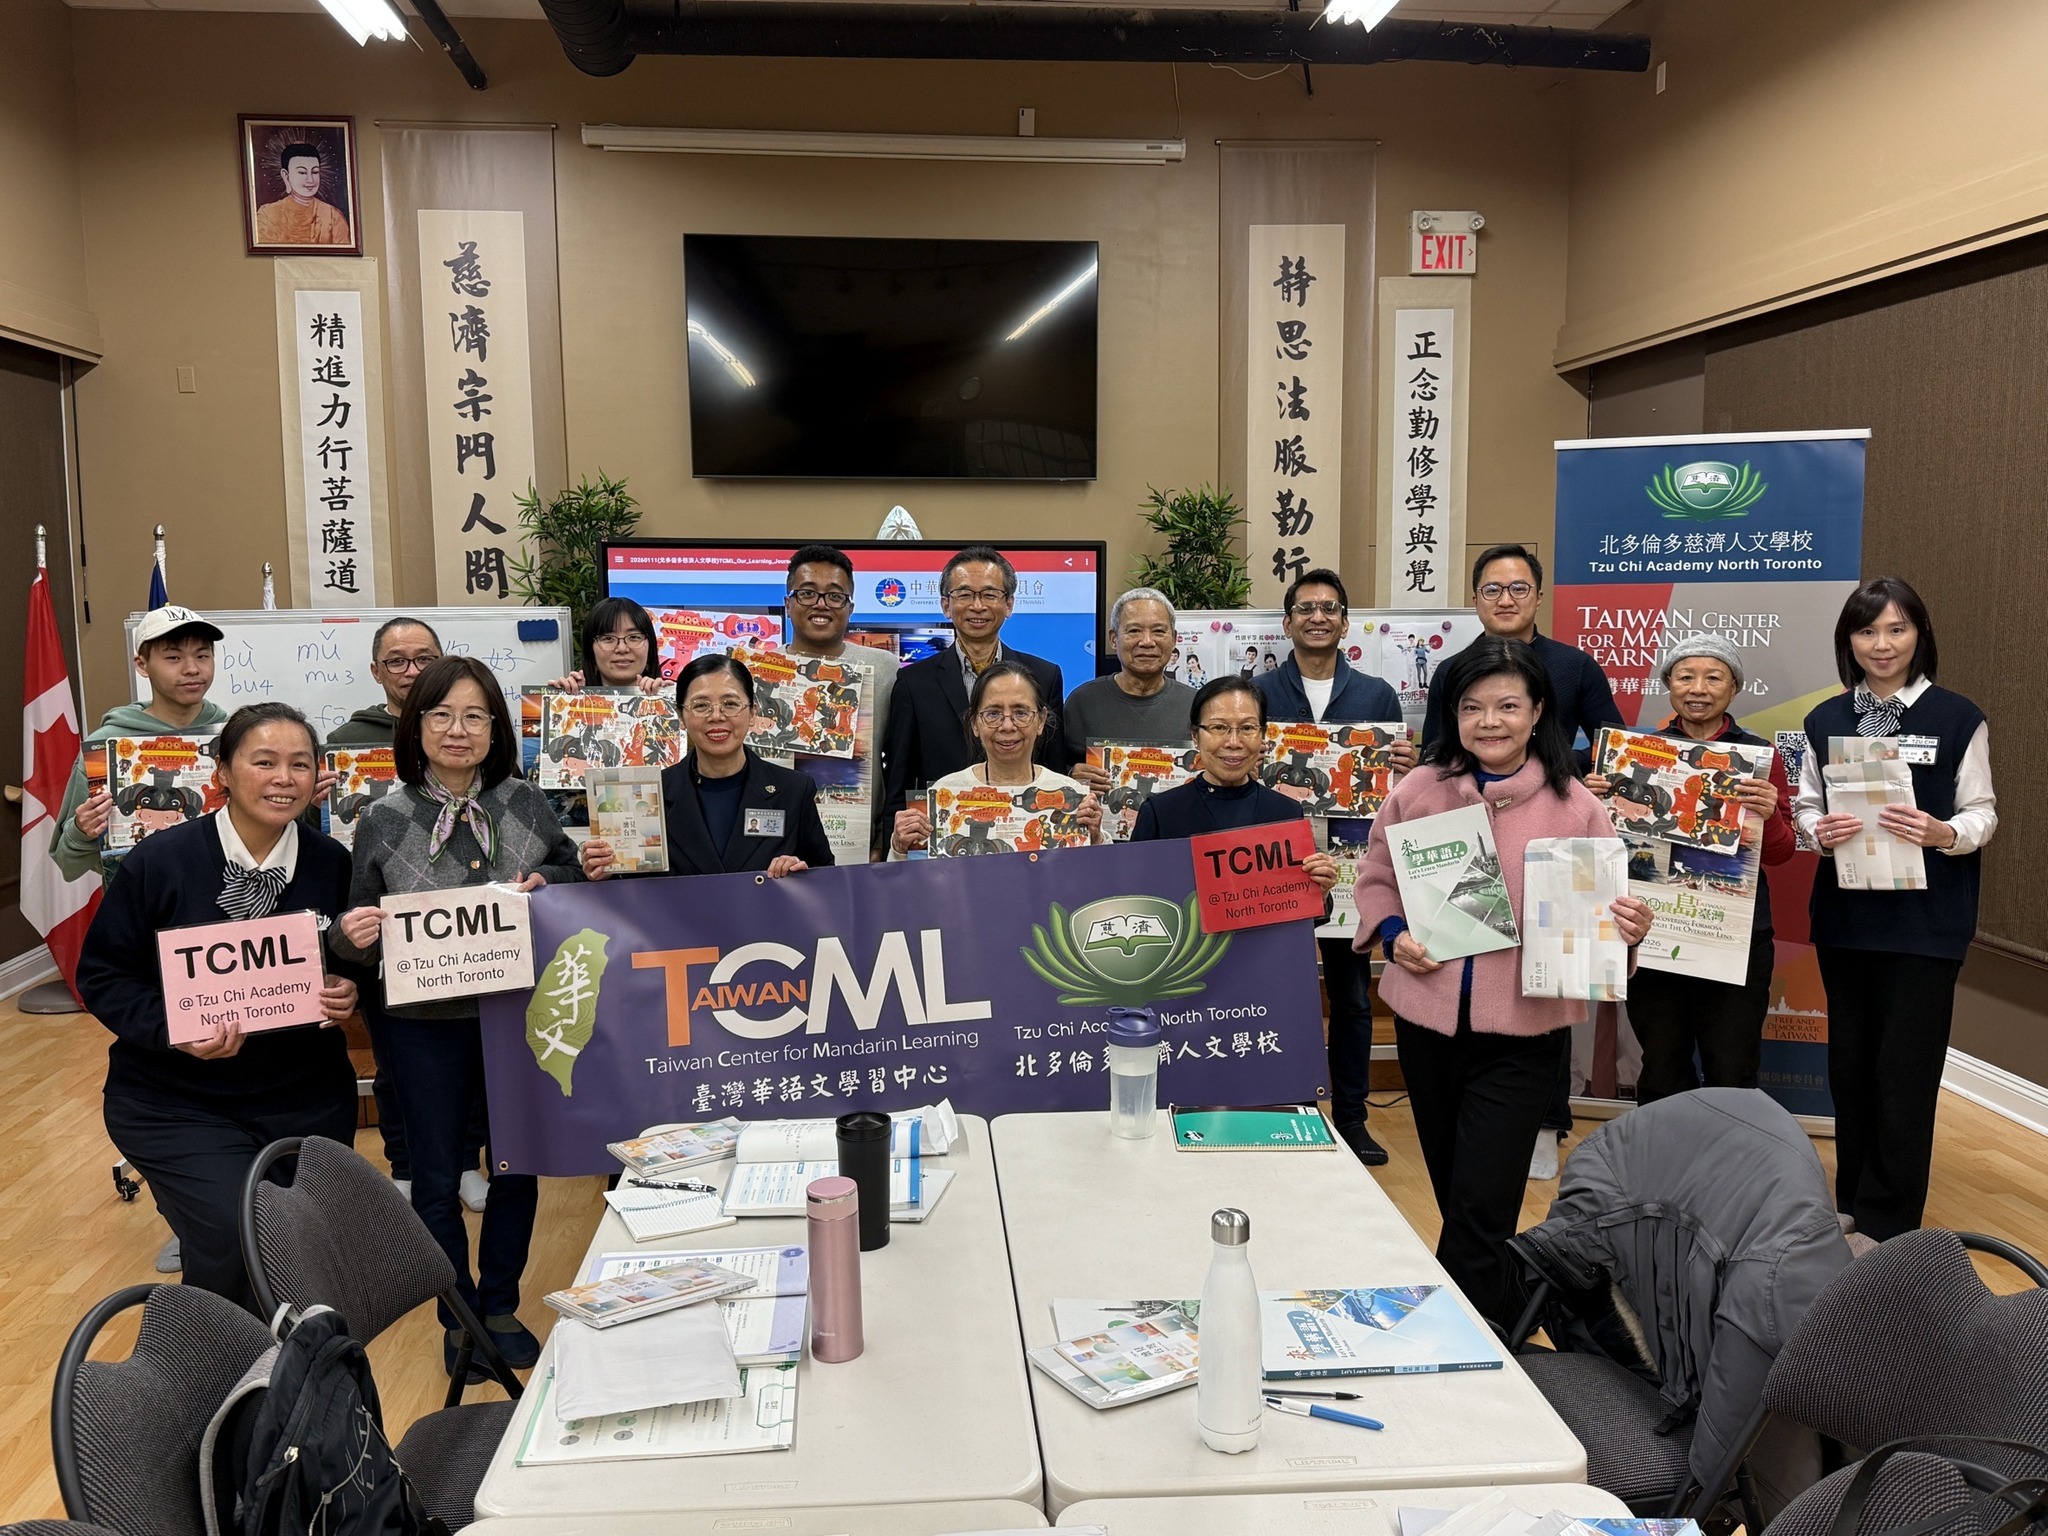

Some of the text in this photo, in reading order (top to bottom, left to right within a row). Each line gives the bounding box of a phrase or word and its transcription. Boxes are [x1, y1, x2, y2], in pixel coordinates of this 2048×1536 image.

[1421, 235, 1467, 269] EXIT
[443, 242, 507, 599] 慈濟宗門人間
[310, 313, 360, 594] 精進力行菩薩道
[1404, 331, 1442, 593] 正念勤修學與覺
[1599, 530, 1813, 556] 北多倫多慈濟人文學校
[1589, 557, 1822, 574] Tzu Chi Academy North Toronto
[1577, 606, 1781, 629] TAIWAN CENTER
[1577, 634, 1616, 648] FOR
[230, 674, 274, 695] bu4
[1204, 839, 1304, 878] TCML
[1436, 860, 1460, 868] Mandarin
[1209, 880, 1311, 905] @ Tzu Chi Academy
[1225, 899, 1298, 919] North Toronto
[394, 902, 517, 943] TCML
[174, 934, 307, 979] TCML
[397, 949, 520, 973] @ Tzu Chi Academy
[416, 968, 505, 988] North Toronto
[631, 928, 992, 1047] TCML
[179, 981, 312, 1011] @ Tzu Chi Academy
[535, 943, 593, 1062] 華文
[200, 1001, 295, 1027] North Toronto
[1014, 1026, 1041, 1040] Tzu
[1047, 1023, 1074, 1038] Chi
[1160, 1009, 1202, 1027] North
[1207, 1004, 1267, 1021] Toronto
[1775, 1016, 1815, 1026] FREE AND
[1767, 1022, 1823, 1033] DEMOCRATIC
[1772, 1030, 1818, 1041] TAIWAN
[645, 1031, 979, 1075] Taiwan Center for Mandarin Learning
[691, 1065, 948, 1112] 臺灣華語文學習中心
